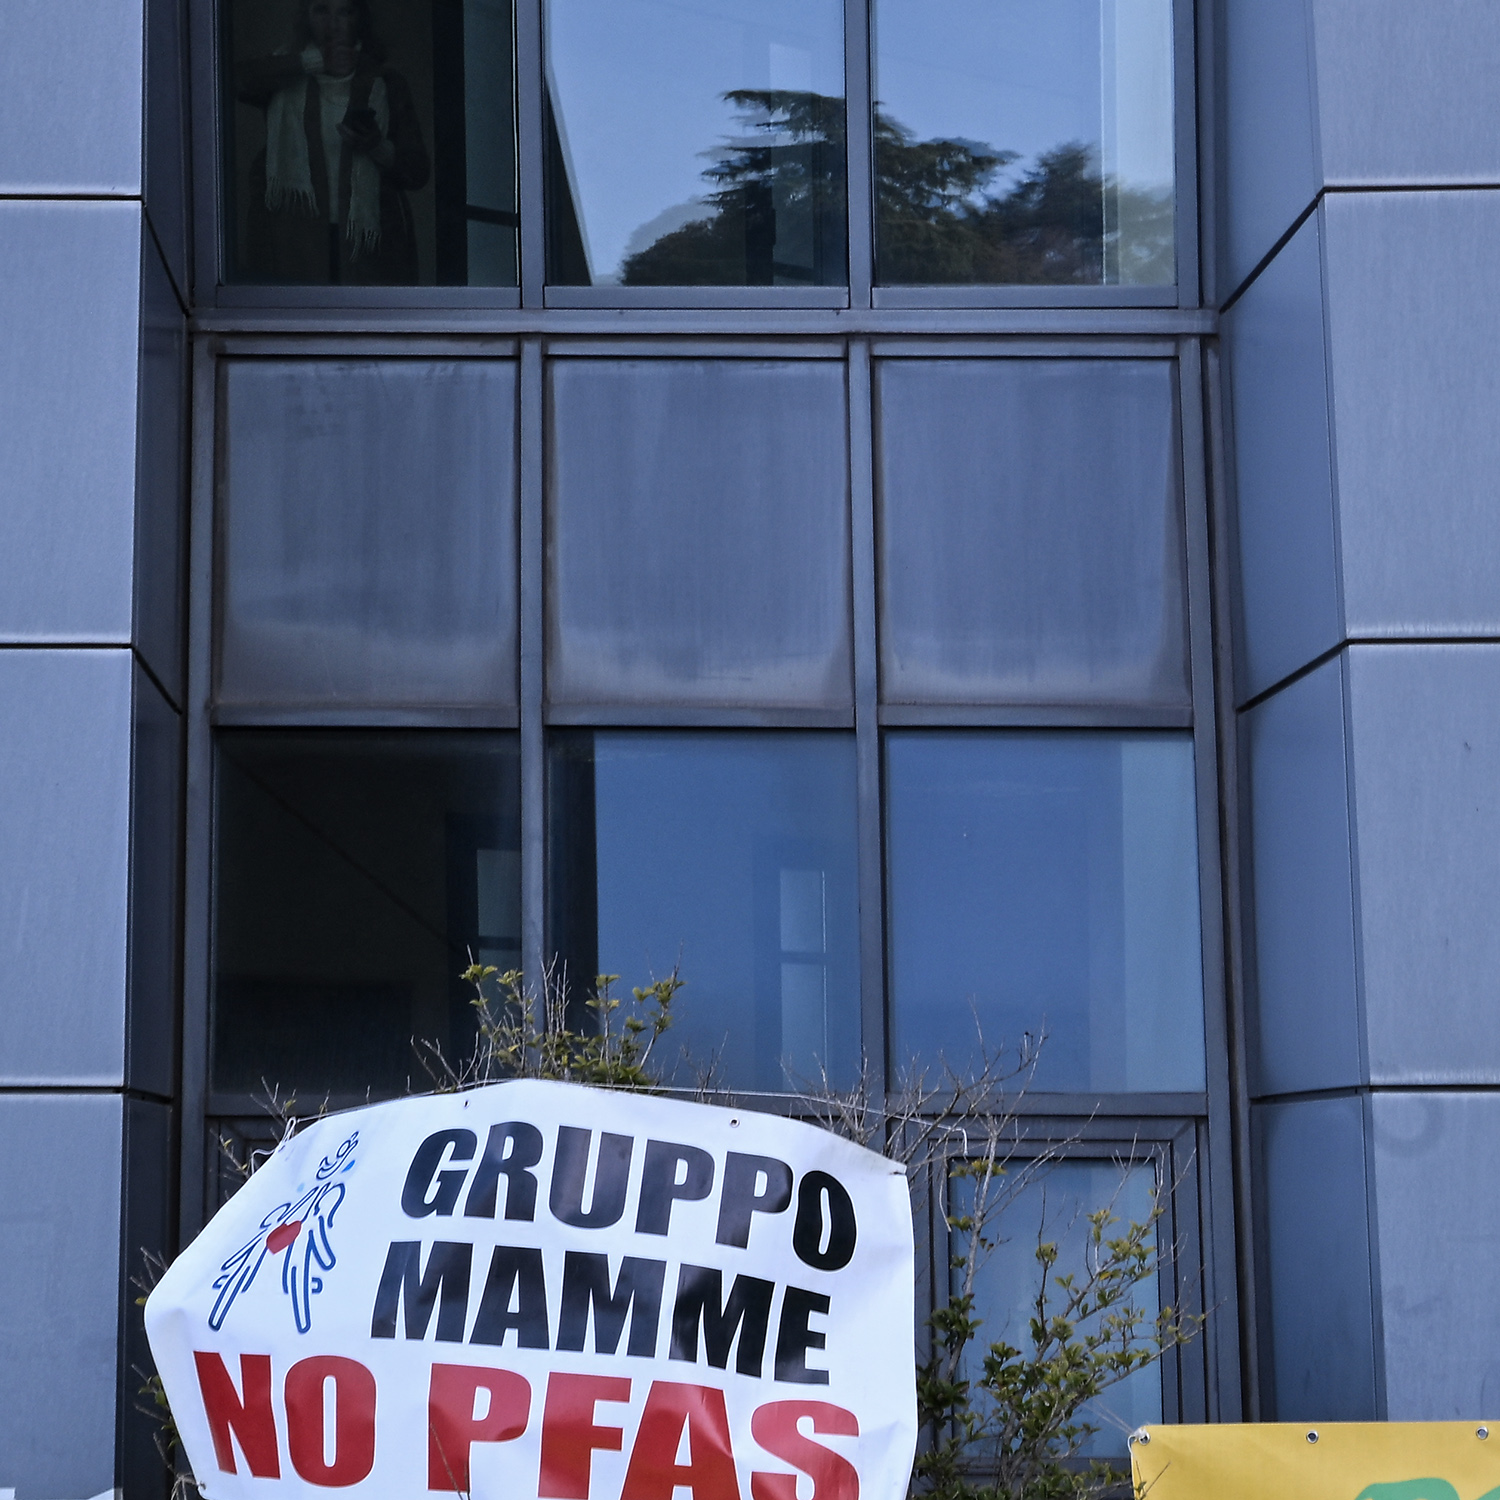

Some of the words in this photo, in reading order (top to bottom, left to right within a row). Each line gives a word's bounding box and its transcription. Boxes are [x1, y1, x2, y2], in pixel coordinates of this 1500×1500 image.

[401, 1121, 857, 1271] GRUPPO
[370, 1241, 830, 1385] MAMME
[194, 1351, 377, 1488] NO
